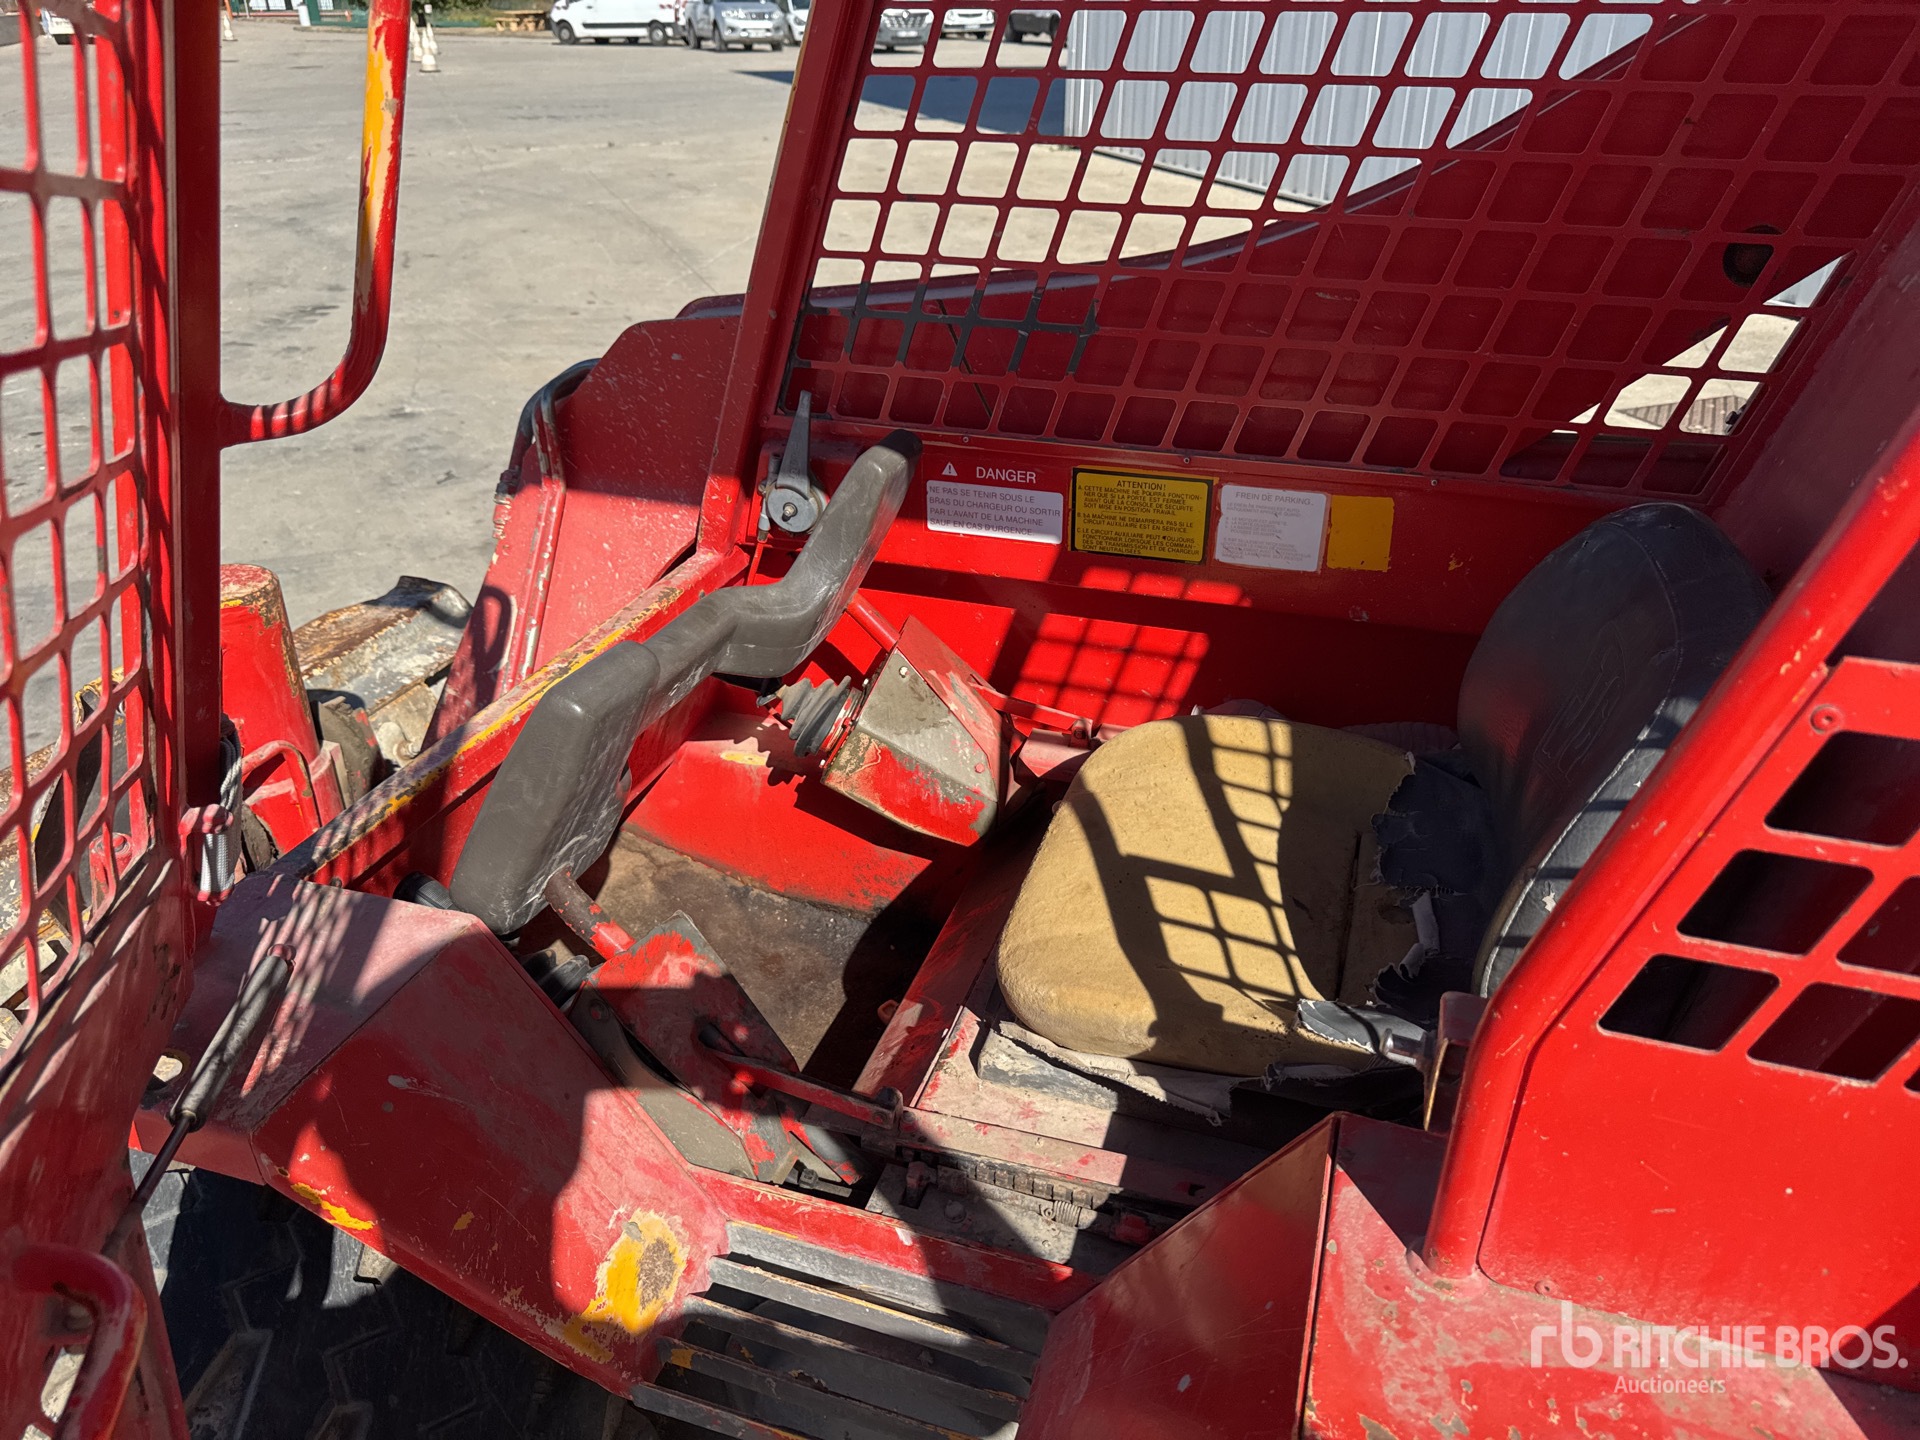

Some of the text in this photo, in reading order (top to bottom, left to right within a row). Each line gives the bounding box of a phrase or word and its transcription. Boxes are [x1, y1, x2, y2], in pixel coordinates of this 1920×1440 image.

[976, 467, 1036, 483] DANGER
[930, 486, 1035, 503] NE PAS SE TENIR SOUS LE
[1235, 492, 1260, 500] FREIN
[1261, 494, 1273, 502] DE
[930, 497, 1060, 517] BRAS DU CHARGEUR OU SORTIR
[930, 508, 1043, 526] PAR L'AVANT DE LA MACHINE
[930, 518, 950, 527] SAUF
[953, 521, 964, 529] EN
[966, 522, 982, 531] CAS
